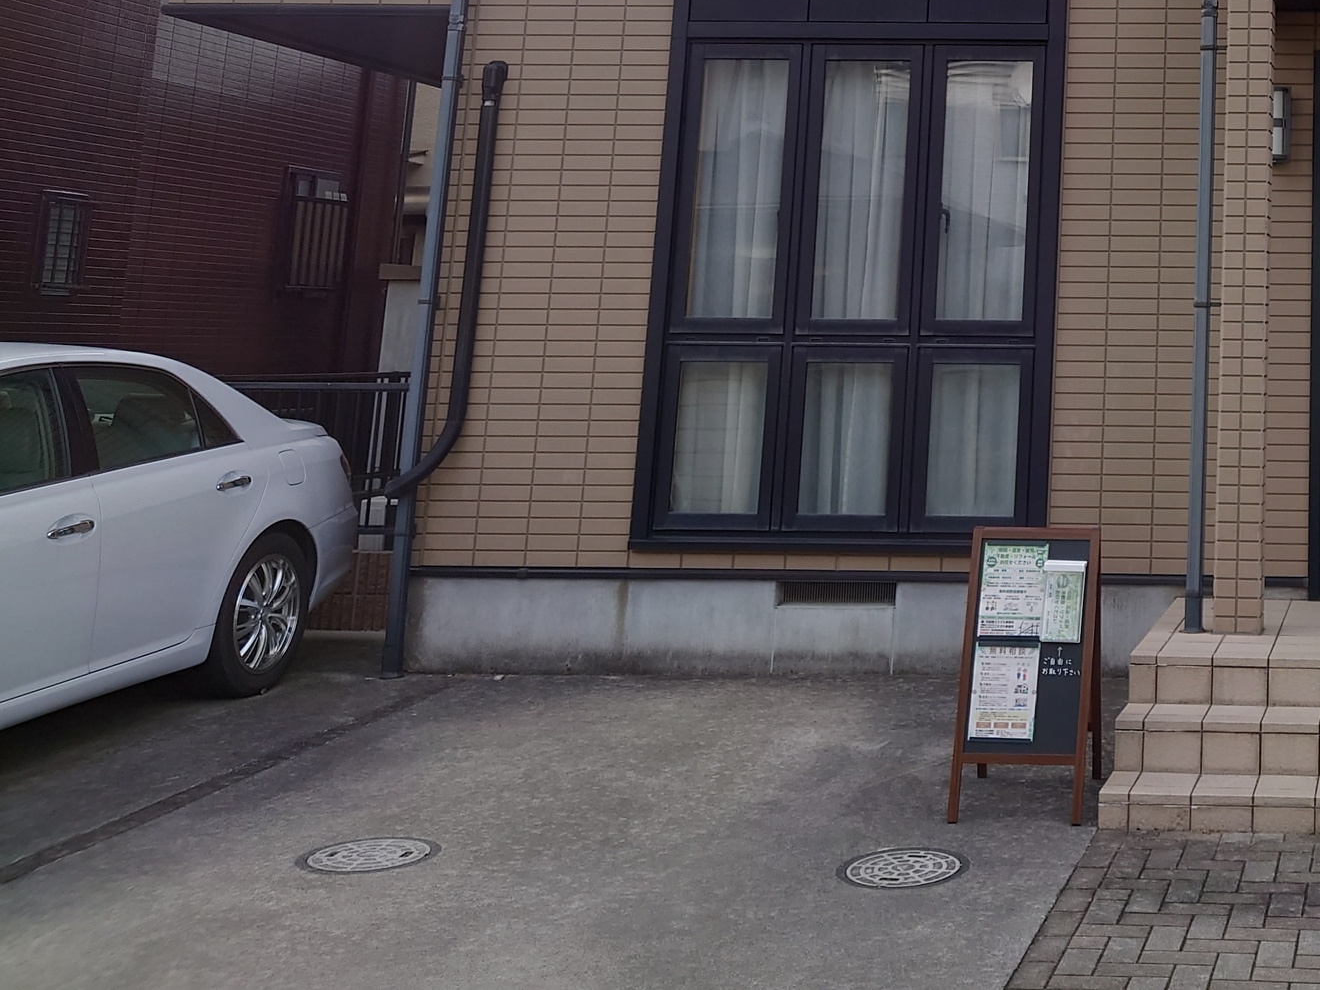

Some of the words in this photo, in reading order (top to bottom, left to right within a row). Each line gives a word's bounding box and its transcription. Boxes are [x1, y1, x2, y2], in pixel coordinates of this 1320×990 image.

[1042, 656, 1073, 666] ご自由に
[1041, 667, 1082, 677] お取り下さい
